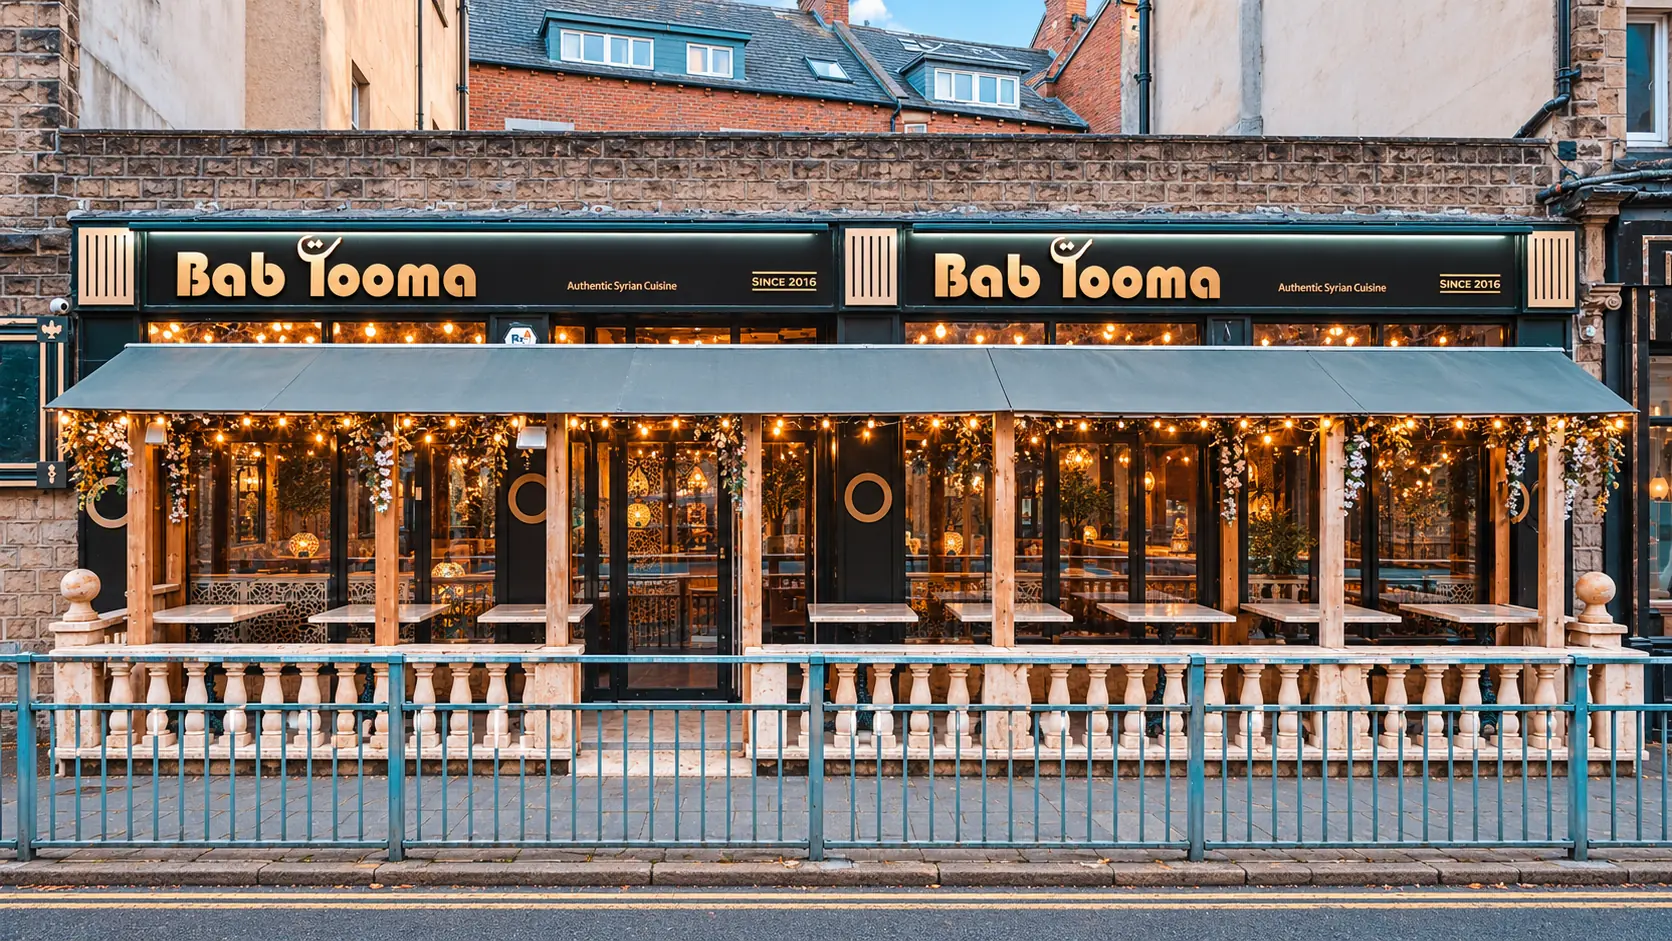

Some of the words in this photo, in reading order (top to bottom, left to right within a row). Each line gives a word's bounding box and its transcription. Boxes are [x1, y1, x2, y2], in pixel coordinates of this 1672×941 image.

[177, 252, 285, 297] Bab
[935, 253, 1041, 298] Bab
[567, 281, 613, 291] Authentic
[613, 281, 643, 293] Syrian
[643, 281, 678, 291] Cuisine
[752, 276, 786, 287] SINCE
[788, 276, 817, 287] 2016
[1439, 279, 1472, 289] SINCE
[1474, 279, 1501, 289] 2016
[1278, 283, 1323, 293] Authentic
[1323, 283, 1353, 295] Syrian
[1353, 283, 1387, 293] Cuisine
